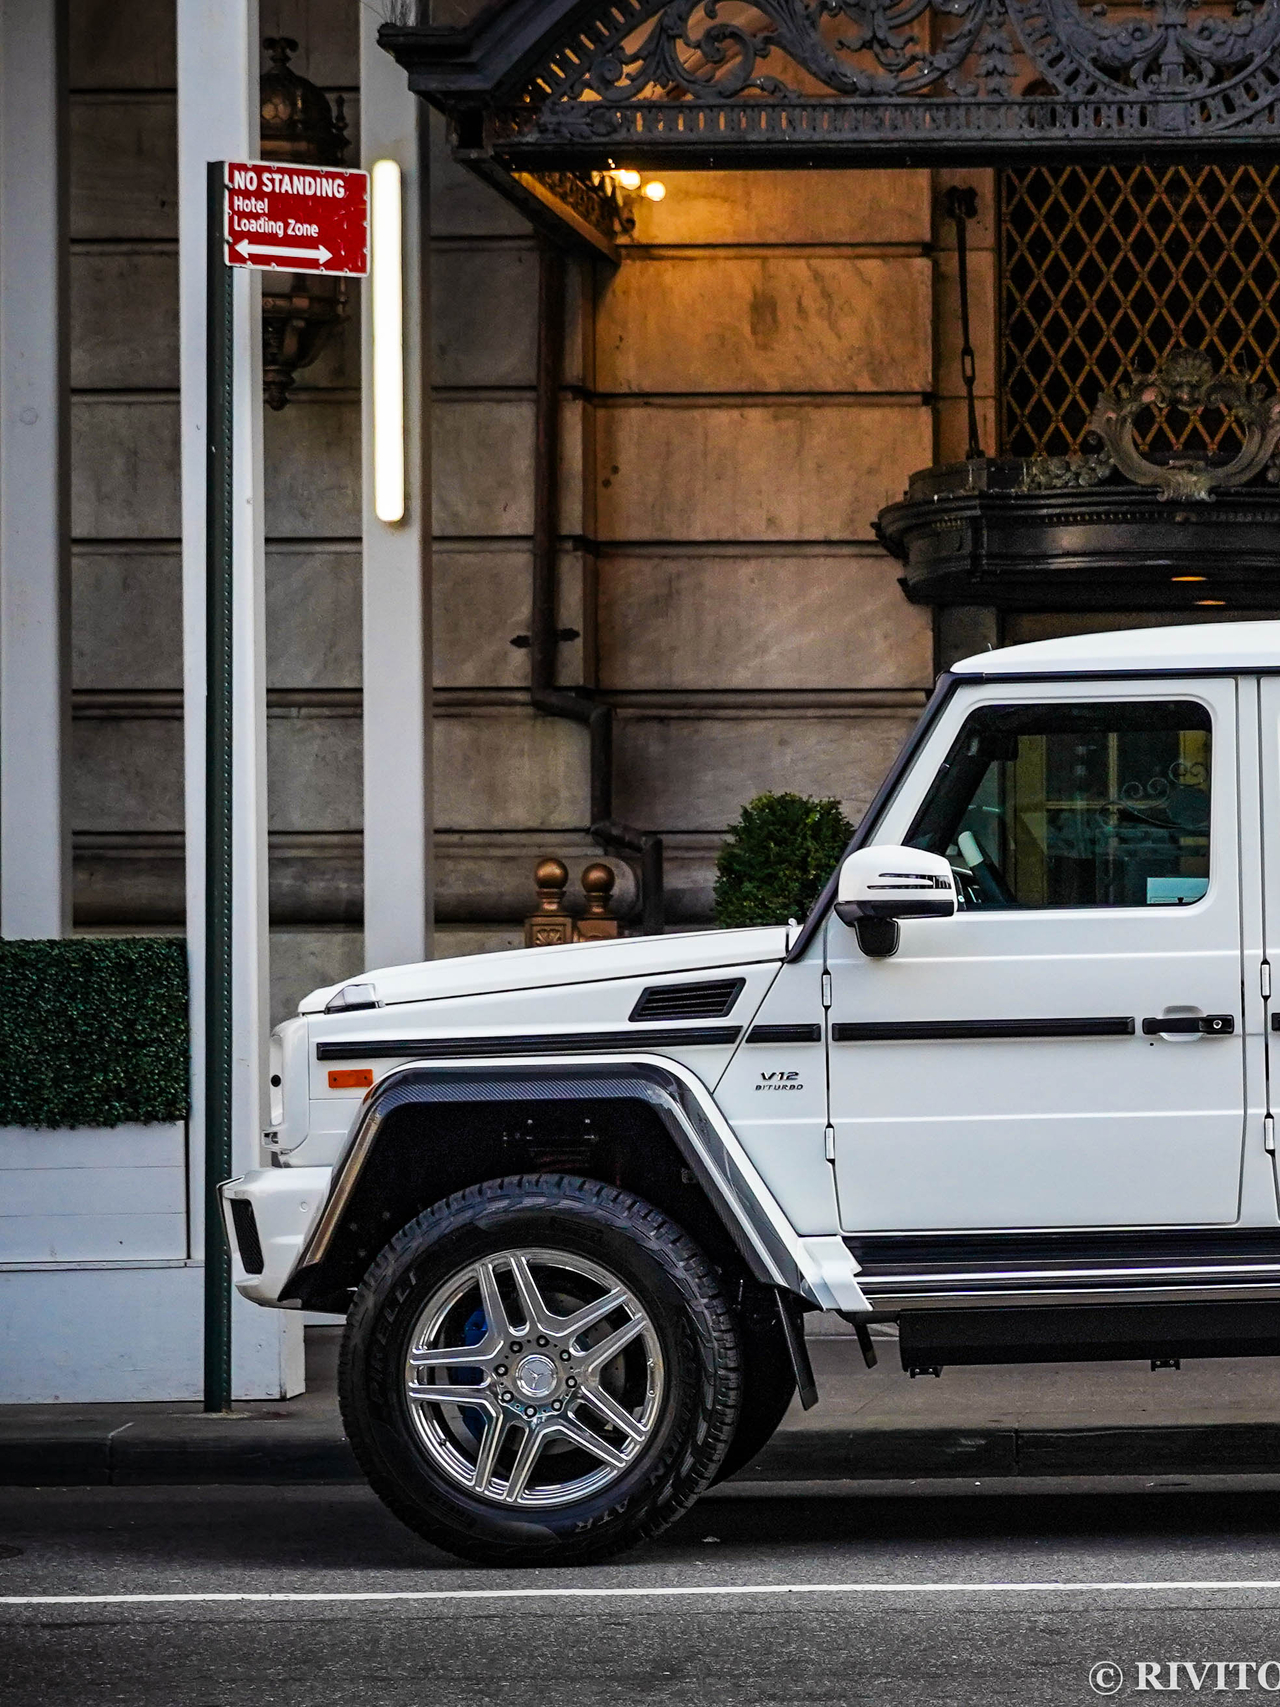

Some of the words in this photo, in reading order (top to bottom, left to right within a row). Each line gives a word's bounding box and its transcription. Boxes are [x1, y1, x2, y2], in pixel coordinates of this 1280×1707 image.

[234, 170, 257, 191] NO
[262, 173, 345, 198] STANDING
[234, 196, 268, 213] Hotel
[234, 215, 284, 237] Loading
[287, 219, 318, 236] Zone
[761, 1072, 799, 1080] V12
